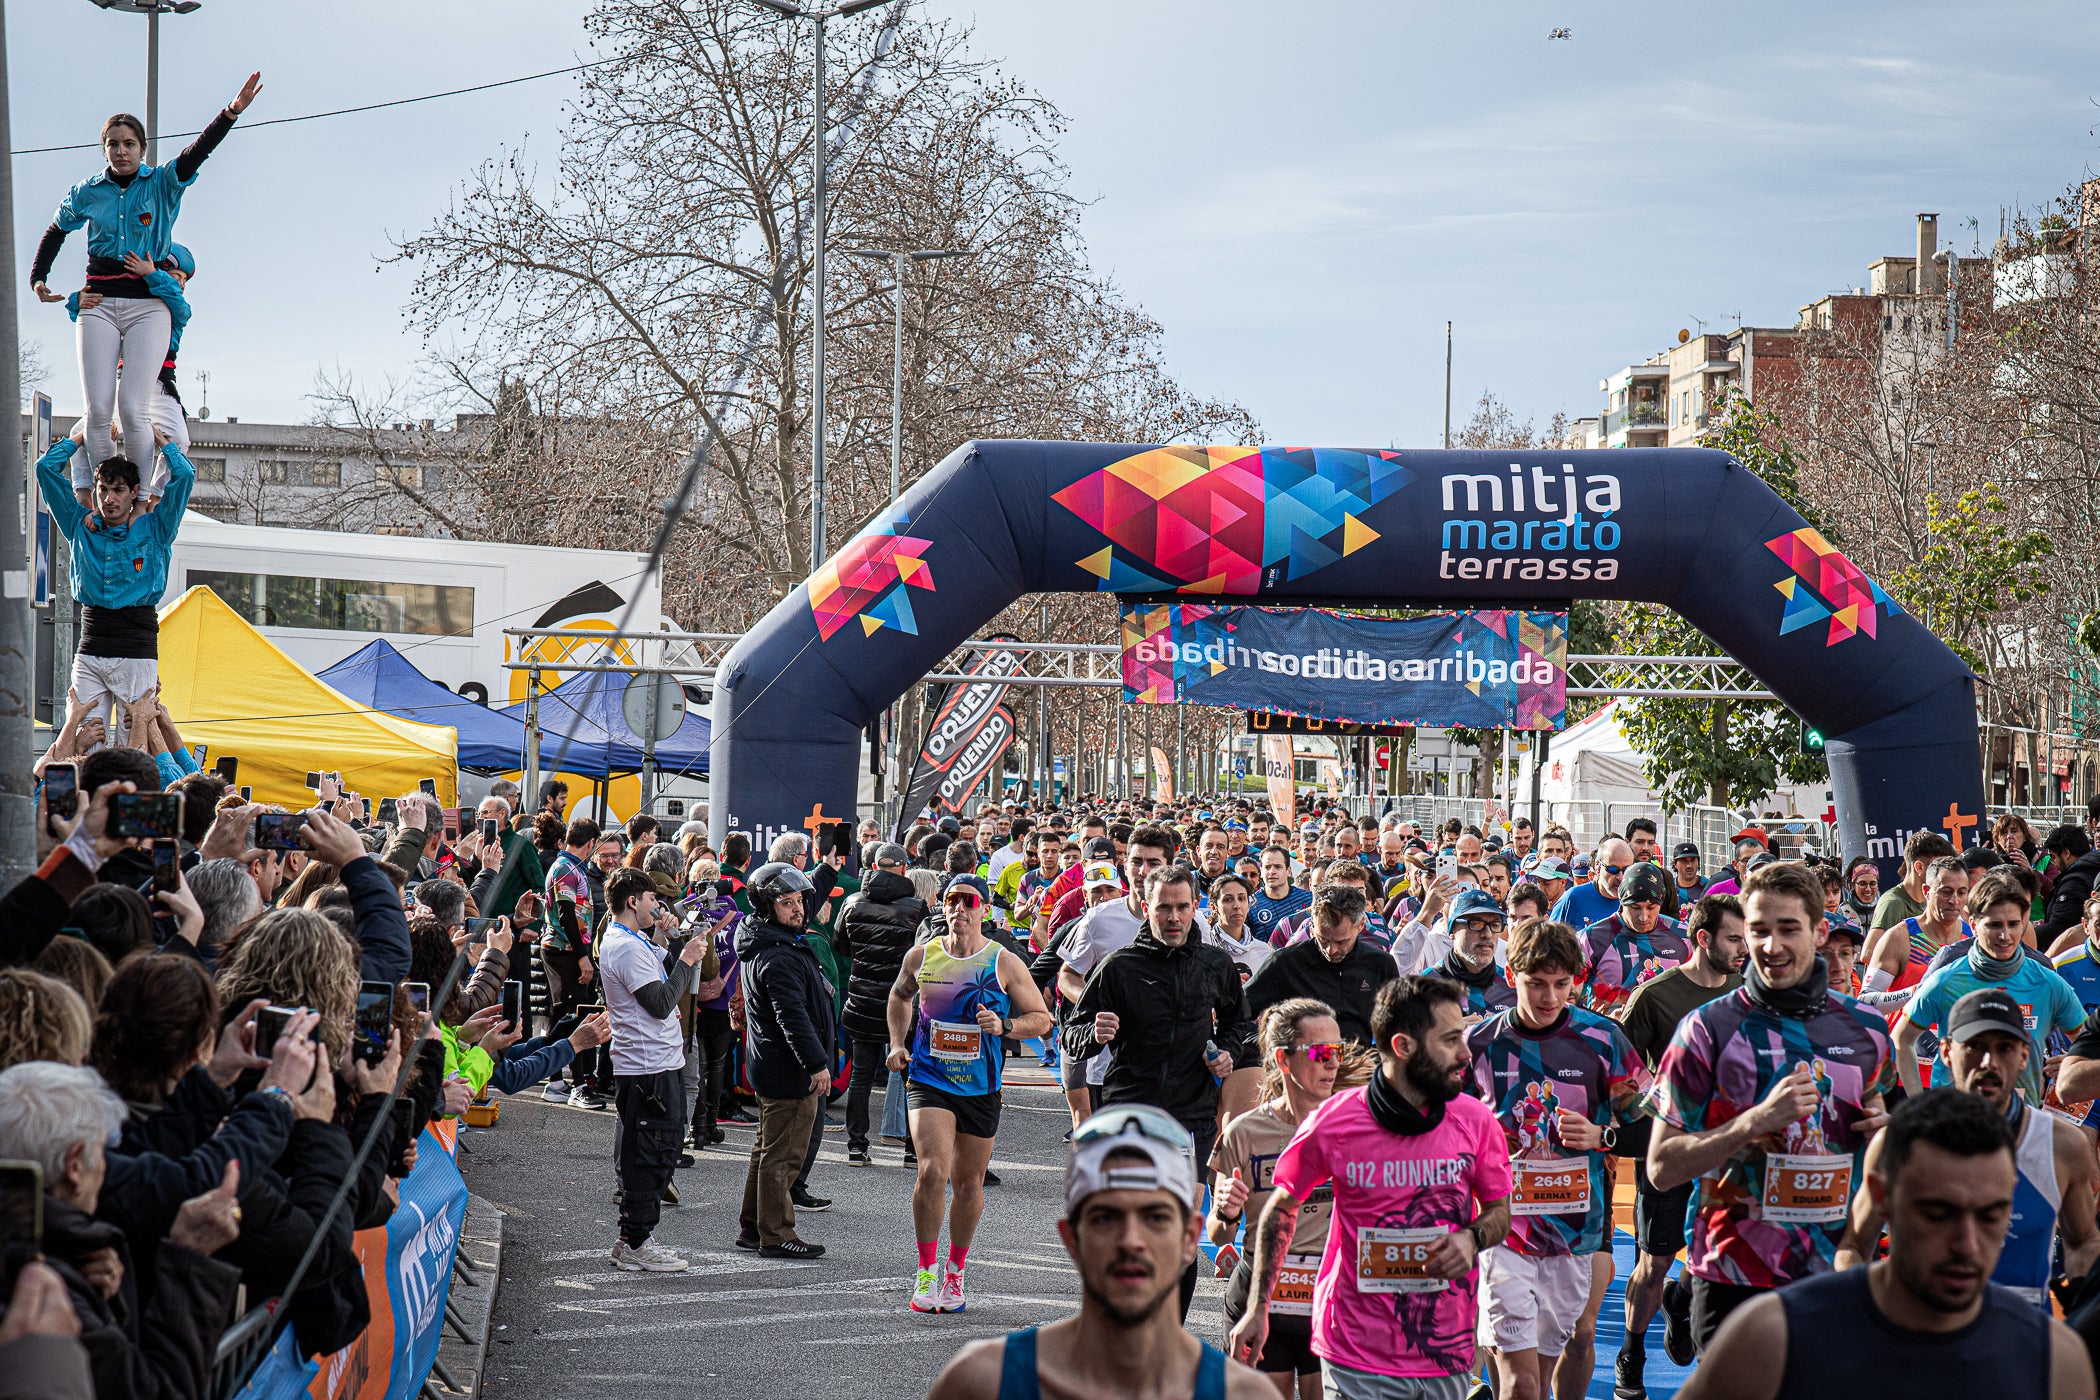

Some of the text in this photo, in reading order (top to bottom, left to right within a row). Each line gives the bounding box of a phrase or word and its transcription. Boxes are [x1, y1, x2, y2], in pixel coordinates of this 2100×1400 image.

[1442, 463, 1622, 527] mitja
[1442, 509, 1622, 551] marató
[1439, 550, 1619, 581] terrassa
[929, 651, 1013, 756] OQUENDO
[941, 716, 1006, 797] OQUENDO
[728, 814, 739, 827] la
[1865, 822, 1877, 835] la
[943, 1032, 967, 1042] 2488
[942, 1043, 968, 1051] RAMON
[2054, 1101, 2075, 1113] PACO
[1346, 1161, 1376, 1188] 912
[1534, 1175, 1572, 1187] 2649
[1793, 1172, 1835, 1190] 827
[1534, 1192, 1572, 1200] BERNAT
[1792, 1195, 1832, 1204] EDUARD
[1303, 1205, 1318, 1214] CC
[1385, 1245, 1428, 1262] 818
[1279, 1271, 1317, 1285] 2643
[1279, 1290, 1313, 1299] LAUR
